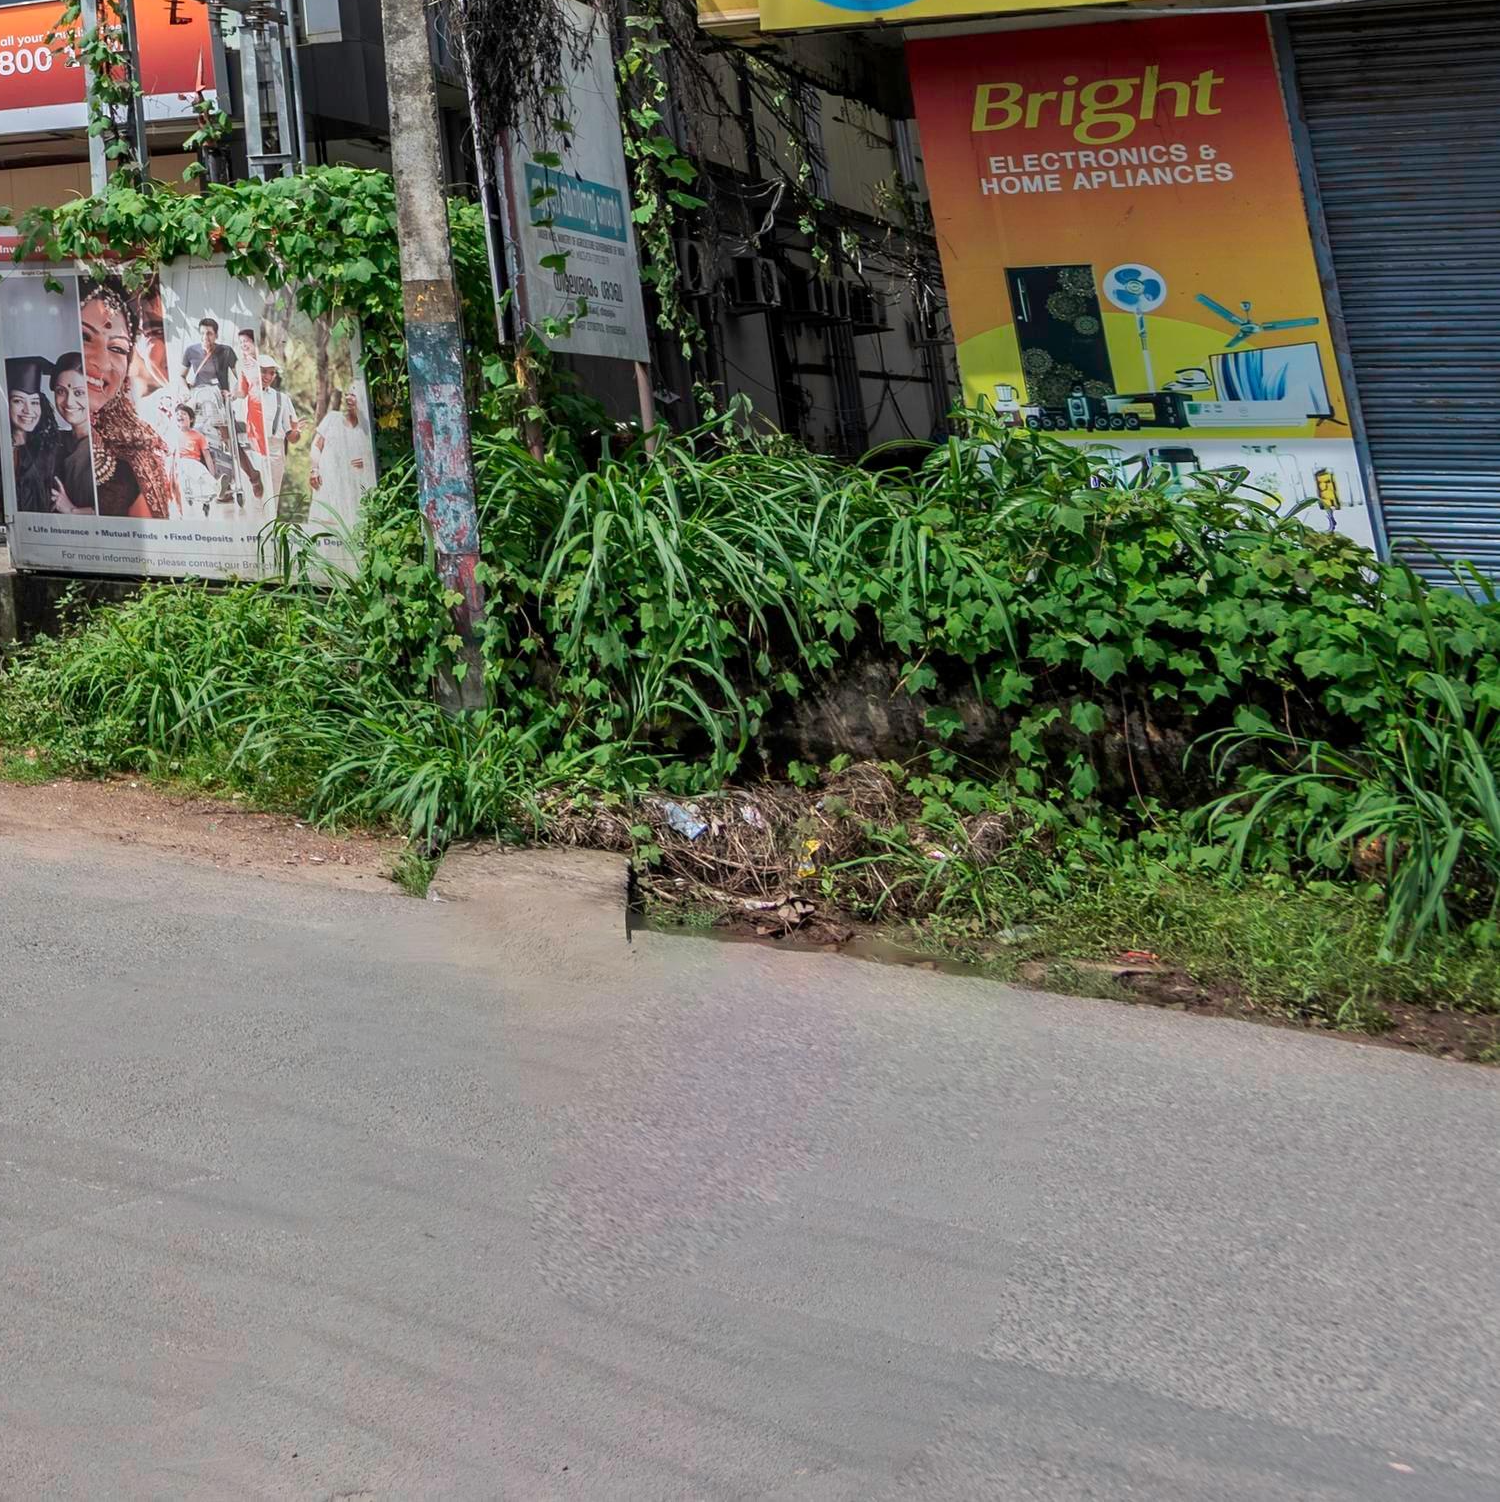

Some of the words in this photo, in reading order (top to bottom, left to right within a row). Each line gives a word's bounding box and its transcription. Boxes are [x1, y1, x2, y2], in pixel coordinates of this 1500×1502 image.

[0, 35, 14, 47] all
[17, 34, 43, 49] your
[971, 65, 1225, 145] Bright
[989, 143, 1188, 174] ELECTRONICS
[1199, 144, 1217, 160] &
[980, 173, 1062, 196] HOME
[1072, 162, 1234, 190] APLIANCES
[50, 527, 89, 536] Insurance
[101, 529, 130, 538] Mutual
[132, 531, 158, 540] Funds
[169, 533, 192, 541] Fixed
[194, 534, 234, 544] Deposits
[62, 550, 75, 559] For
[78, 552, 100, 561] more
[102, 553, 153, 565] information,
[158, 557, 190, 569] please
[194, 559, 223, 568] contact
[225, 561, 240, 569] our
